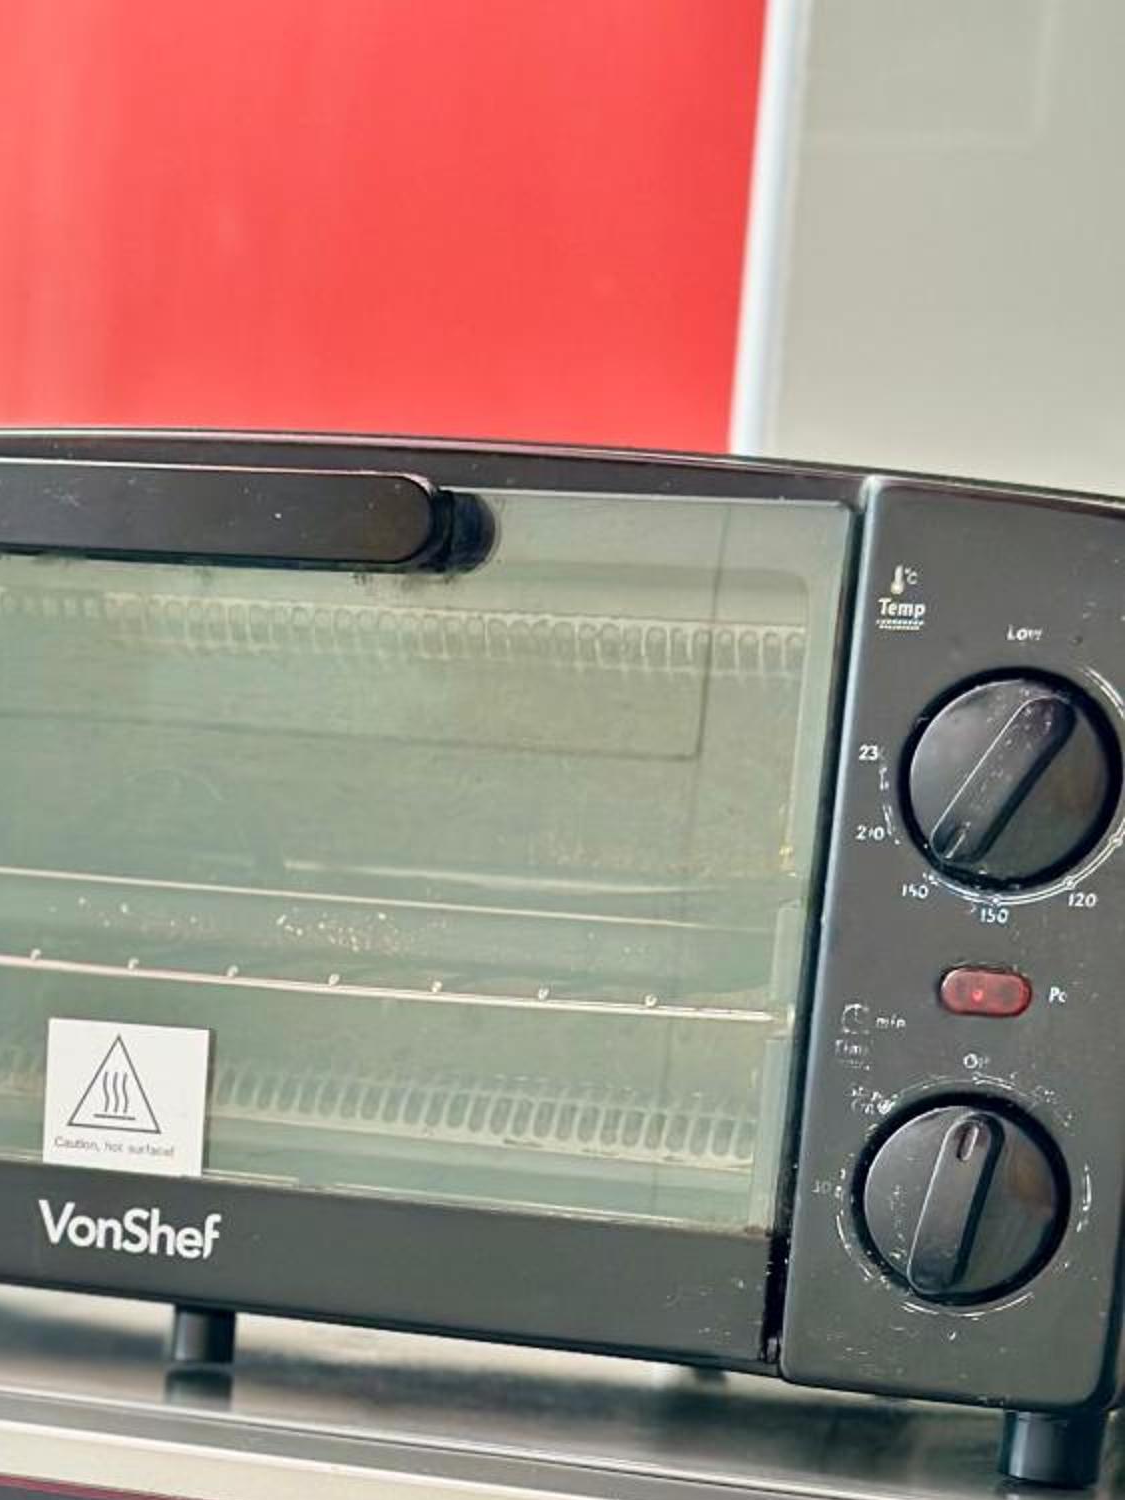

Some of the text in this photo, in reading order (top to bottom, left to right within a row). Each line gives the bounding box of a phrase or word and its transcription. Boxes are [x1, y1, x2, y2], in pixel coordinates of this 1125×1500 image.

[878, 597, 926, 618] Temp
[1068, 892, 1098, 908] 120
[980, 907, 1009, 924] 150
[38, 1198, 223, 1260] VonShef
